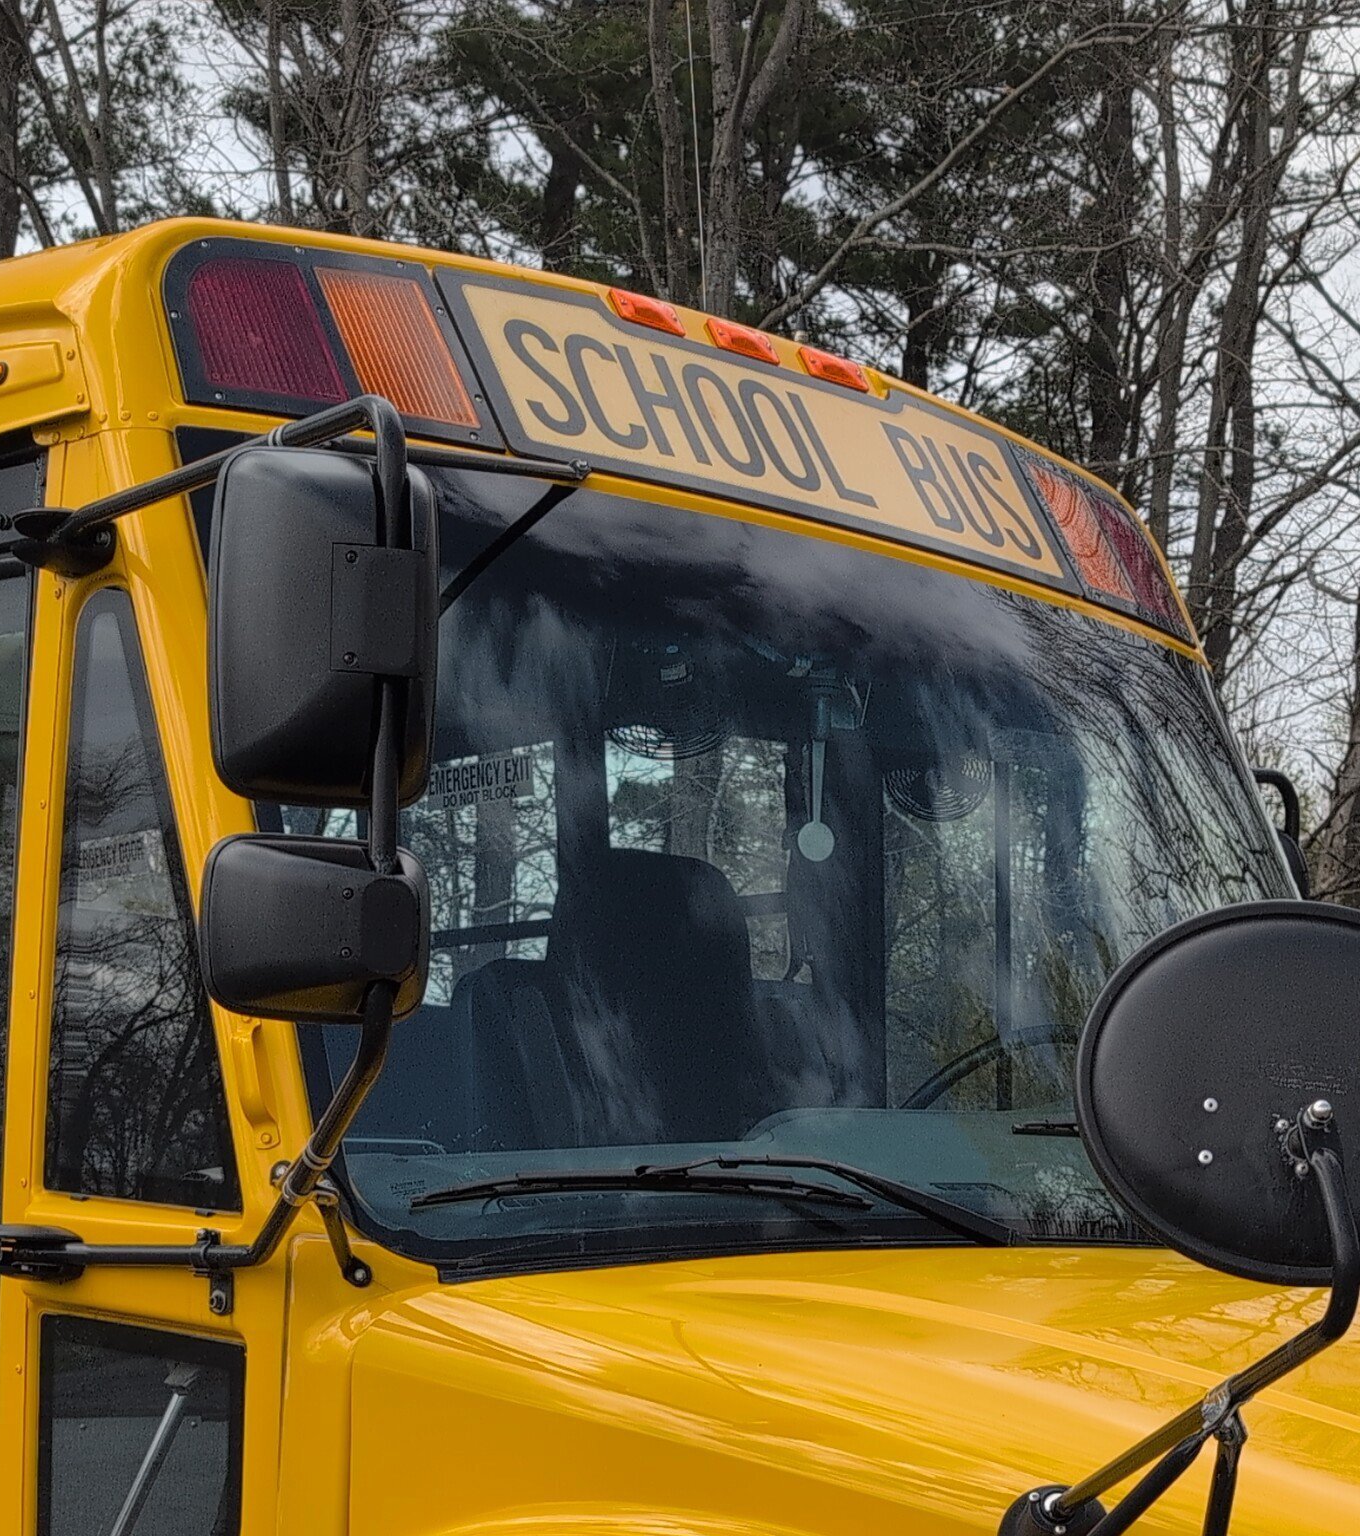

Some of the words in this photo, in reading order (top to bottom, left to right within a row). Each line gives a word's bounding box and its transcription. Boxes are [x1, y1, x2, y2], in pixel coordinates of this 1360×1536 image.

[502, 317, 878, 509] SCHOOL
[883, 420, 1042, 561] BUS
[429, 761, 501, 796] EMERGENCY
[504, 755, 531, 784] EXIT
[443, 795, 457, 808] DO
[459, 790, 480, 806] NOT
[482, 784, 518, 802] BLOCK
